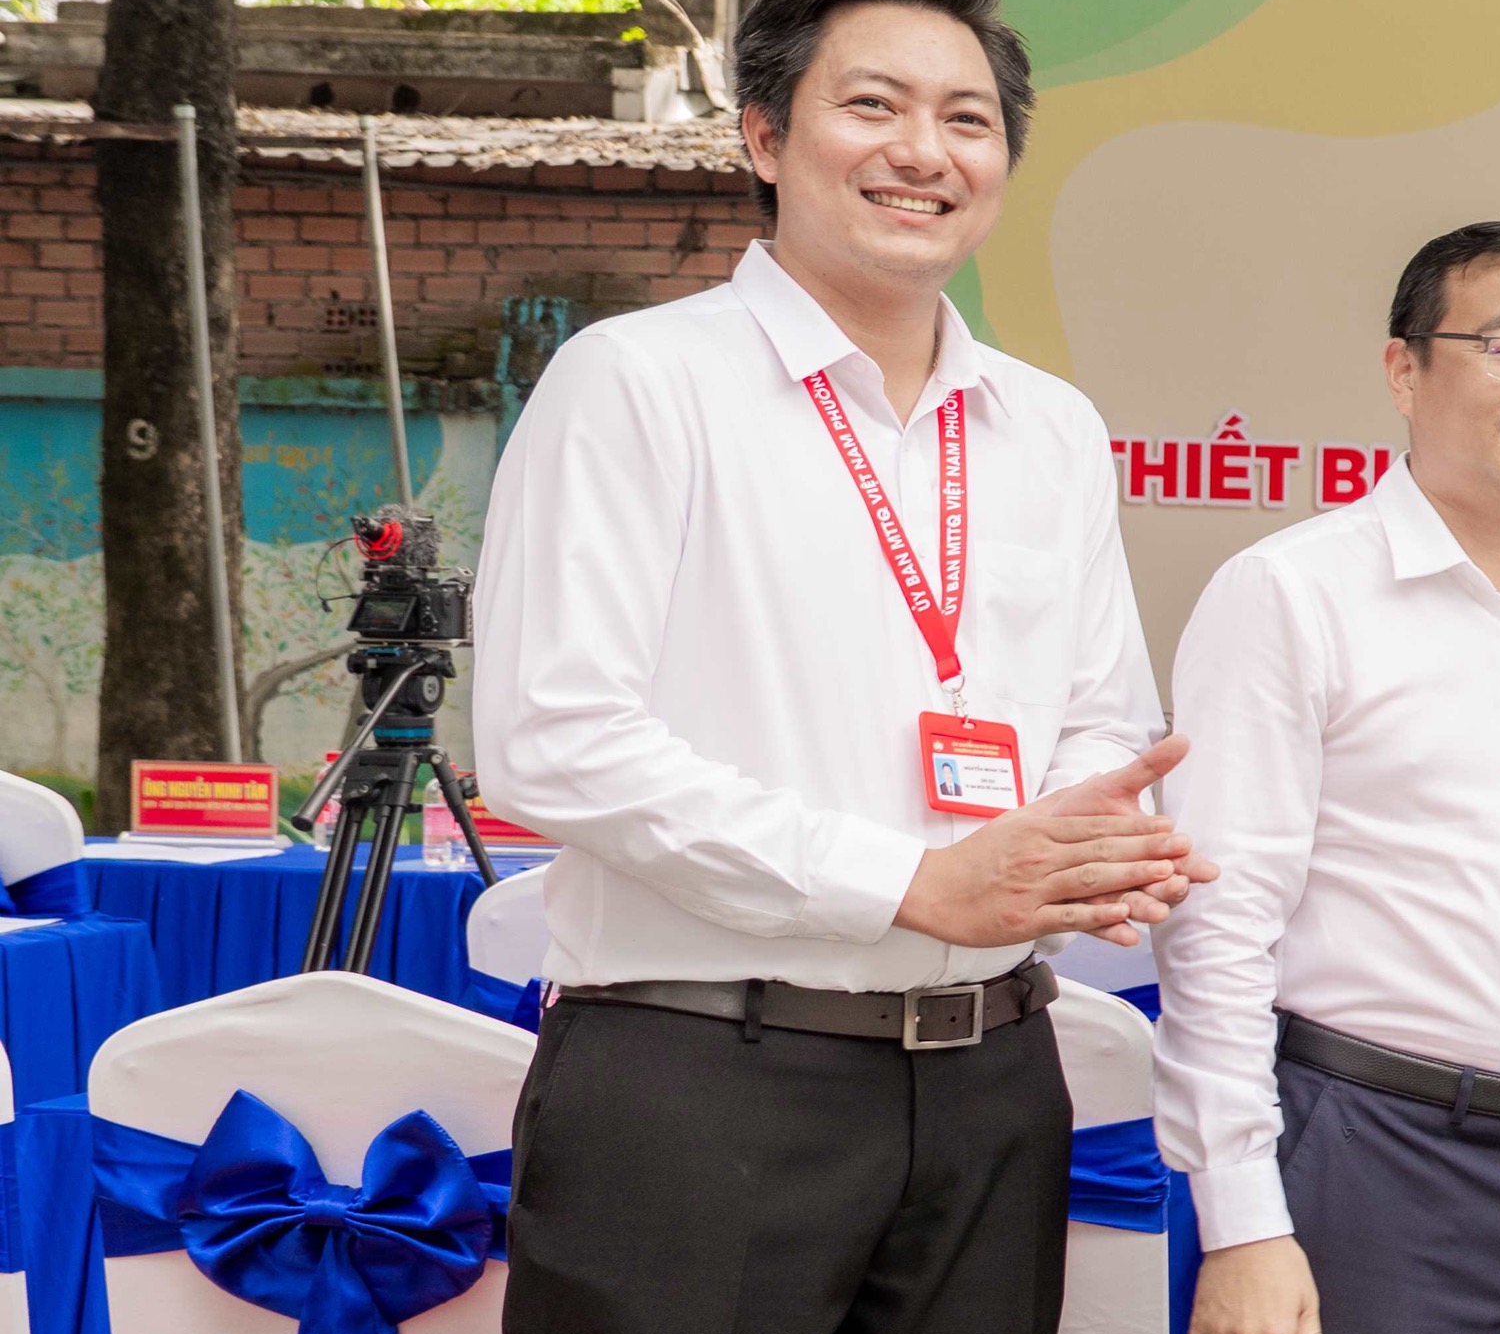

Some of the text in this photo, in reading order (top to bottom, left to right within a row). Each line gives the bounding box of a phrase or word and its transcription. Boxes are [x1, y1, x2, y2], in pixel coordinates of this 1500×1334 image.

[126, 418, 158, 461] 9
[839, 433, 867, 471] NAM
[946, 442, 961, 477] NAM
[858, 473, 883, 505] VIỆT
[943, 480, 965, 511] VIỆT
[876, 506, 906, 551] MTTQ
[946, 514, 961, 556] MTTQ
[895, 552, 921, 587] BAN
[946, 559, 960, 592] BAN
